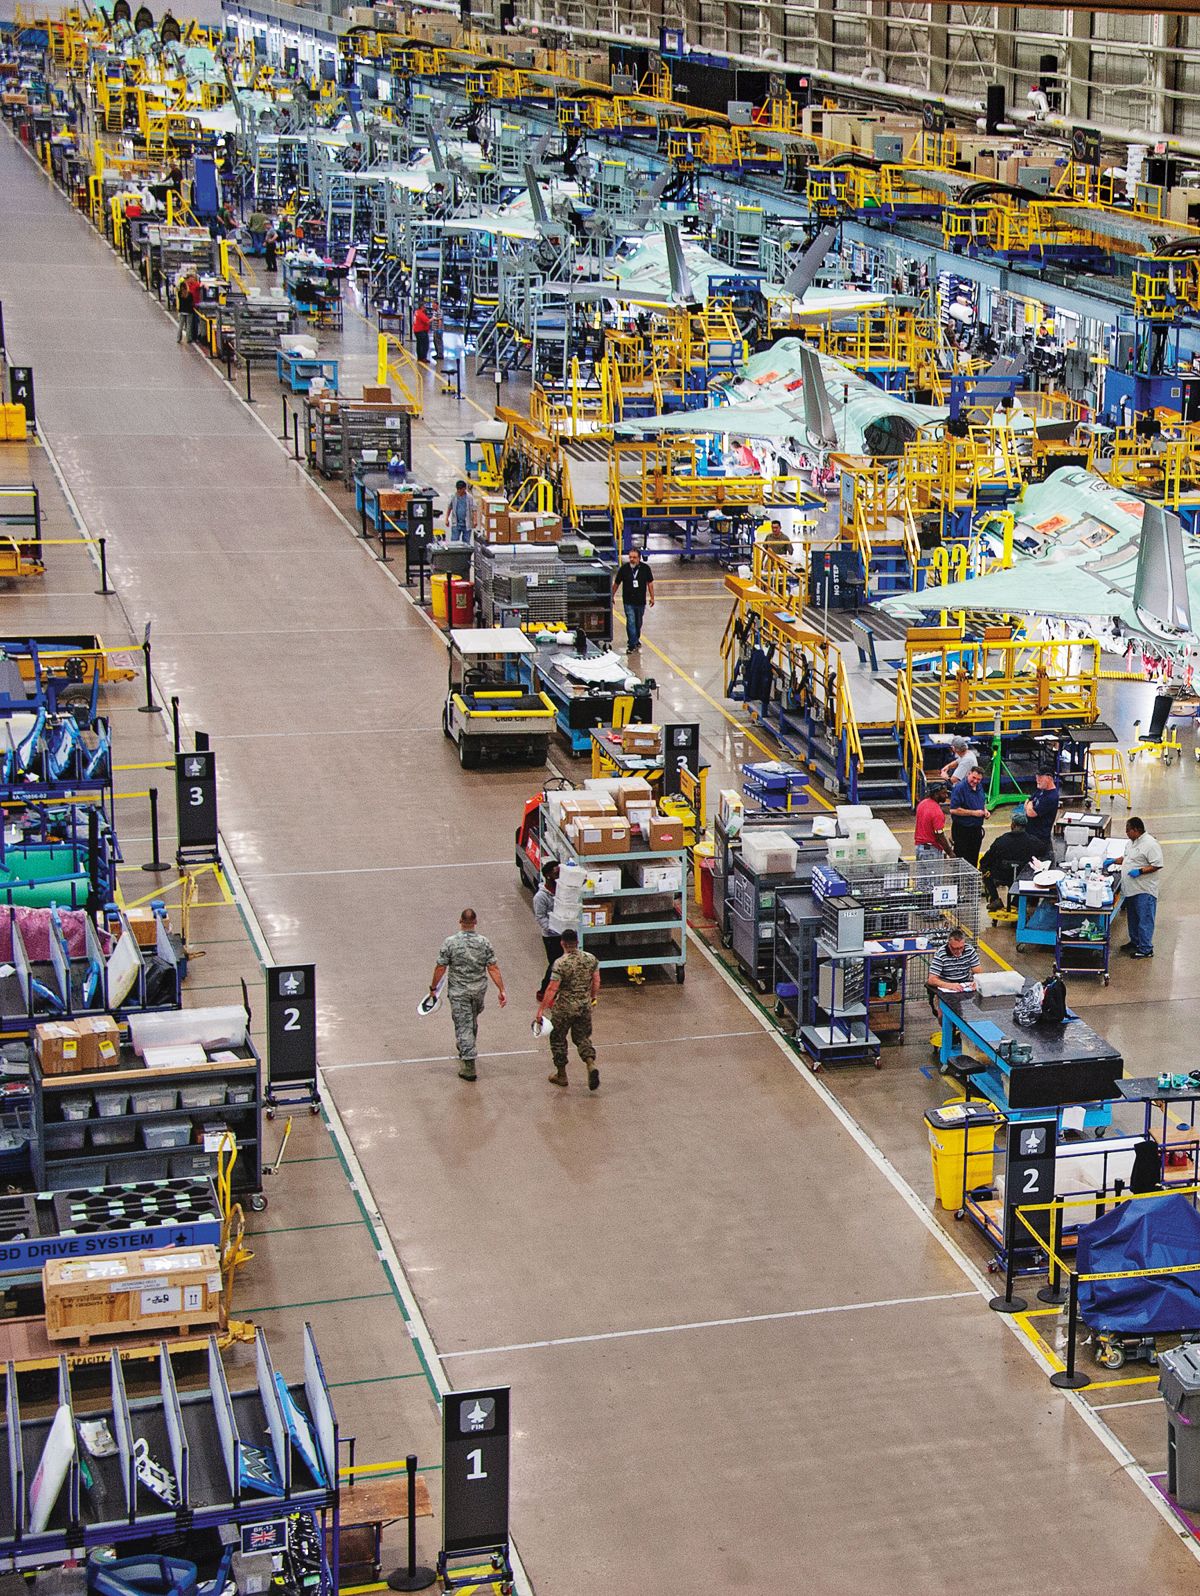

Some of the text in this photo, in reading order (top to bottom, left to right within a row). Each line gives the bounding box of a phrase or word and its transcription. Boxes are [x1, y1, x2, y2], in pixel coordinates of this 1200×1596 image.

[17, 386, 28, 398] 4
[415, 523, 426, 538] 4
[832, 563, 841, 596] NO STEP
[189, 786, 205, 806] 3
[284, 1007, 302, 1031] 2
[1022, 1168, 1040, 1194] 2
[28, 1241, 79, 1258] DRIVE
[85, 1233, 155, 1251] SYSTEM
[470, 1423, 484, 1431] FIN
[466, 1448, 488, 1480] 1
